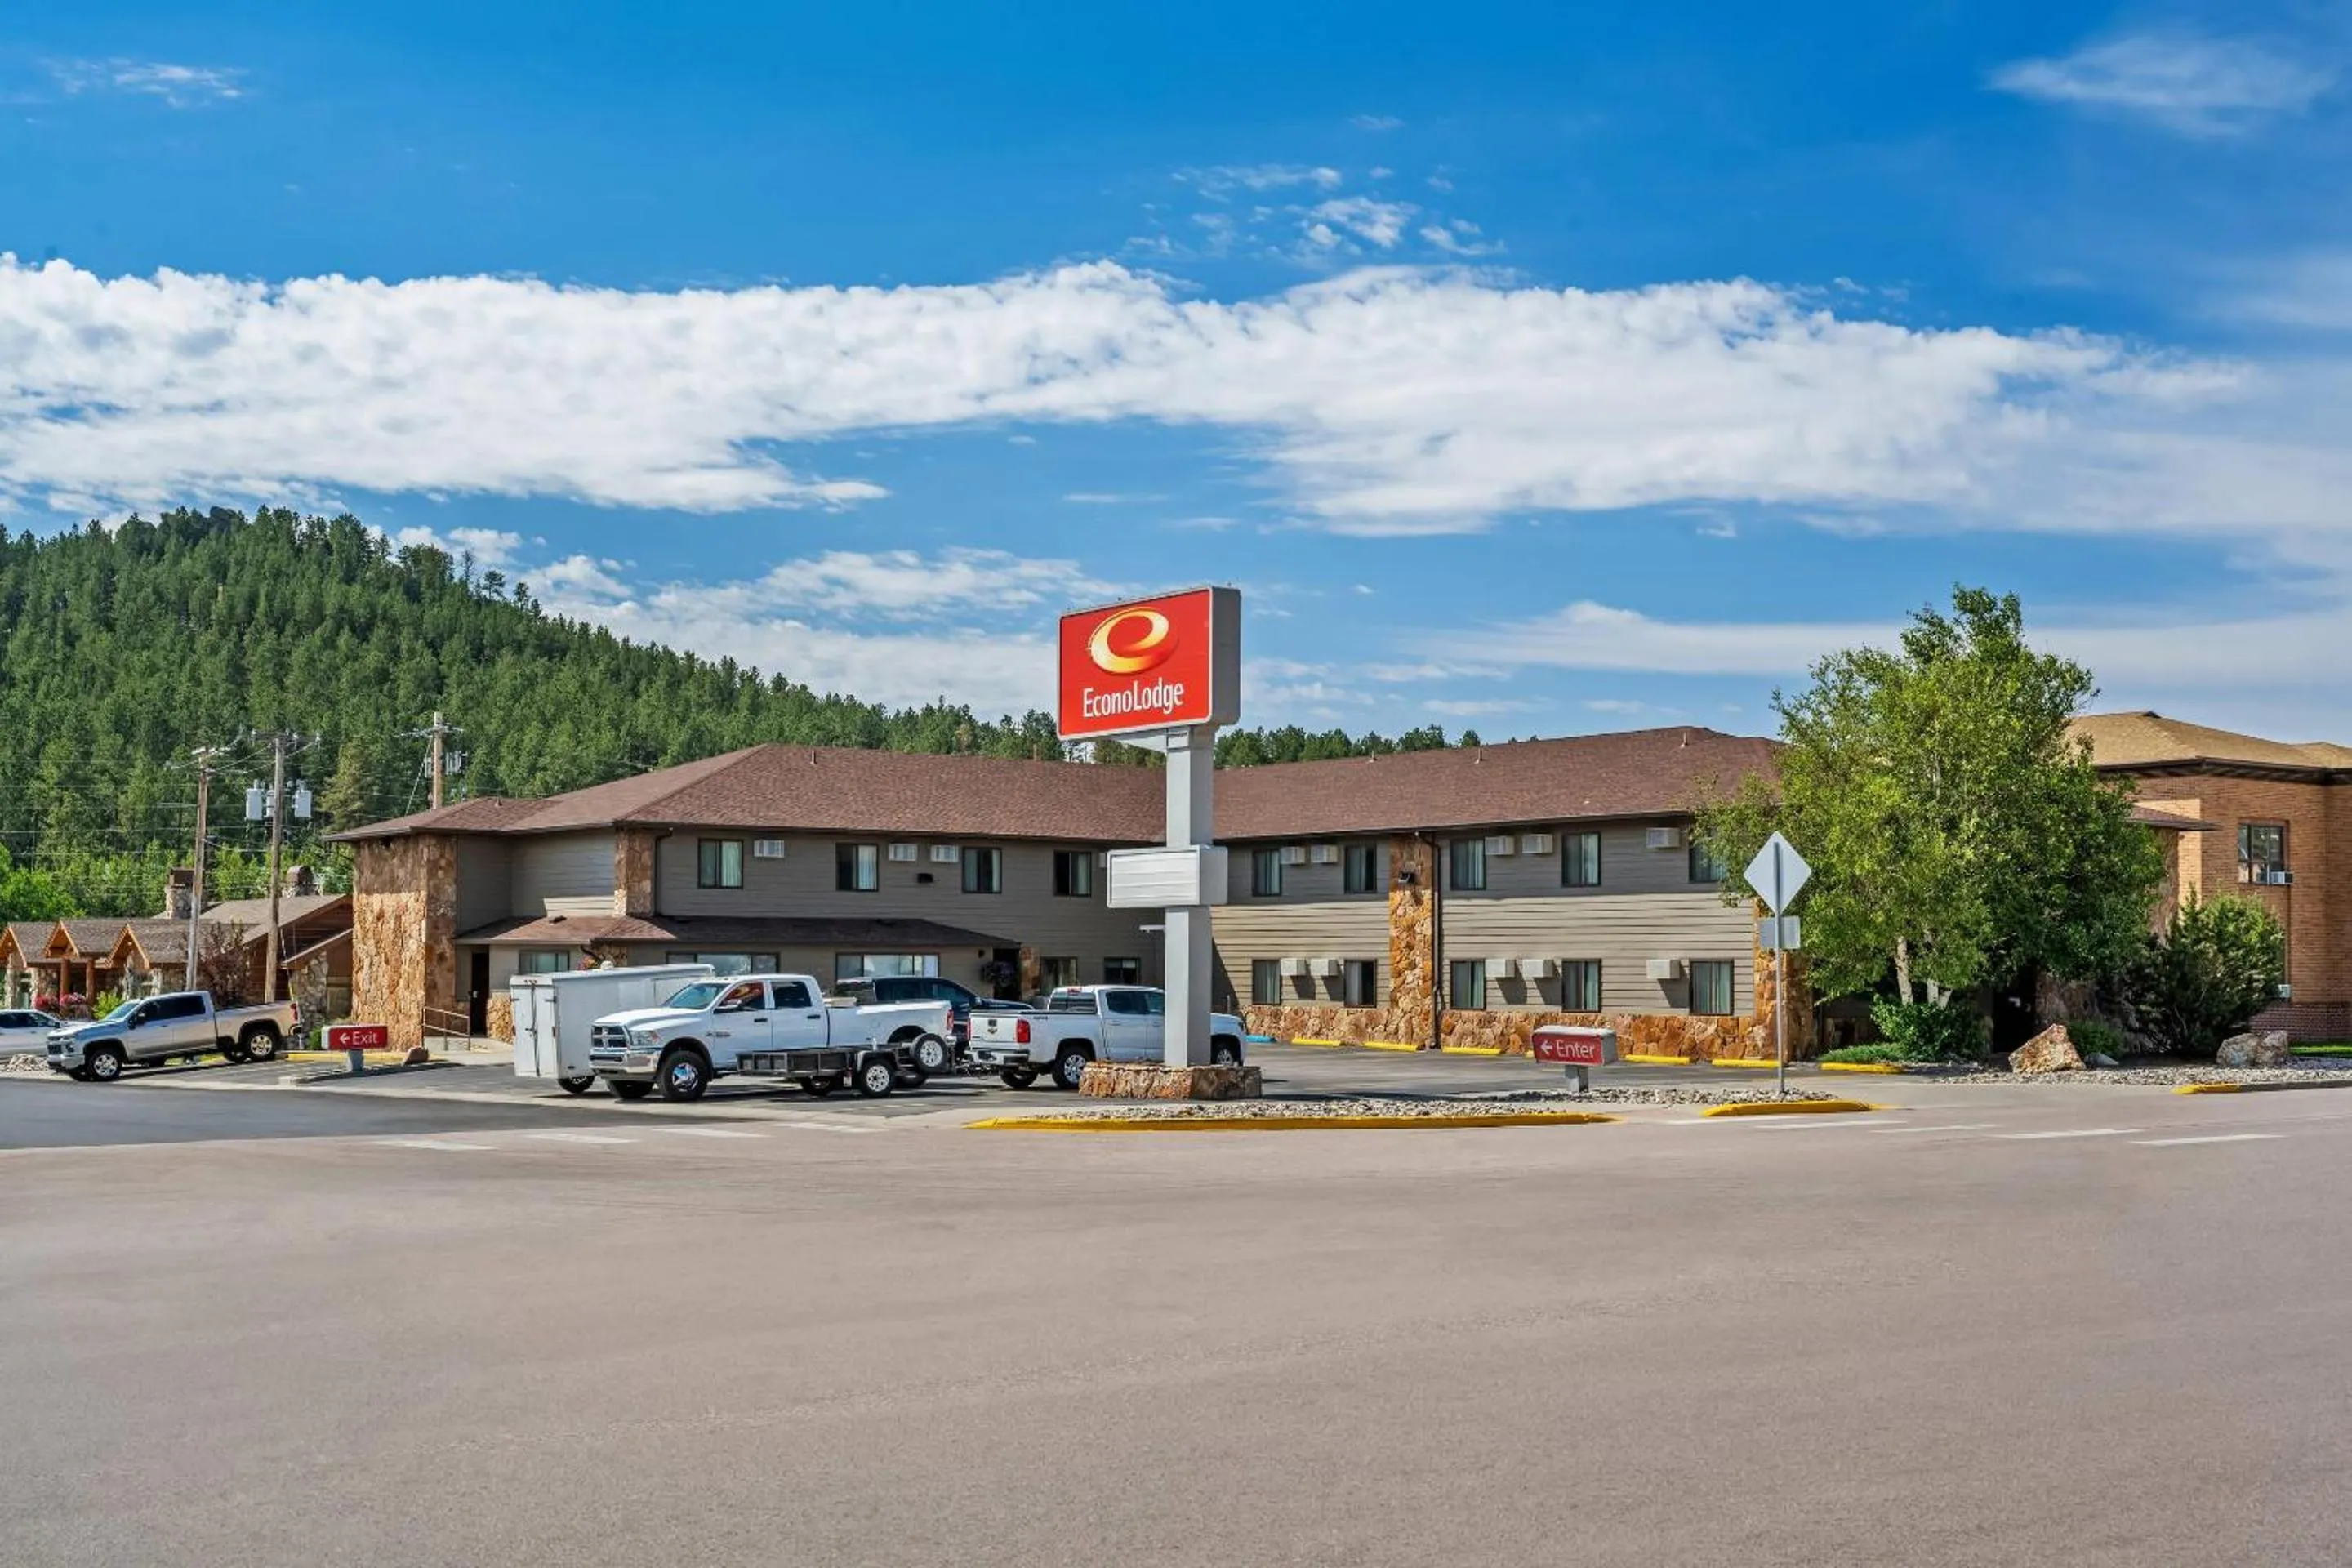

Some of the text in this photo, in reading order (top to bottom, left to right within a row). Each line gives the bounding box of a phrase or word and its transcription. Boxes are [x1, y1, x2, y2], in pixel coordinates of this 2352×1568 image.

[1083, 677, 1184, 717] EconoLodge
[352, 1031, 378, 1045] Exit
[1556, 1039, 1595, 1058] Enter
